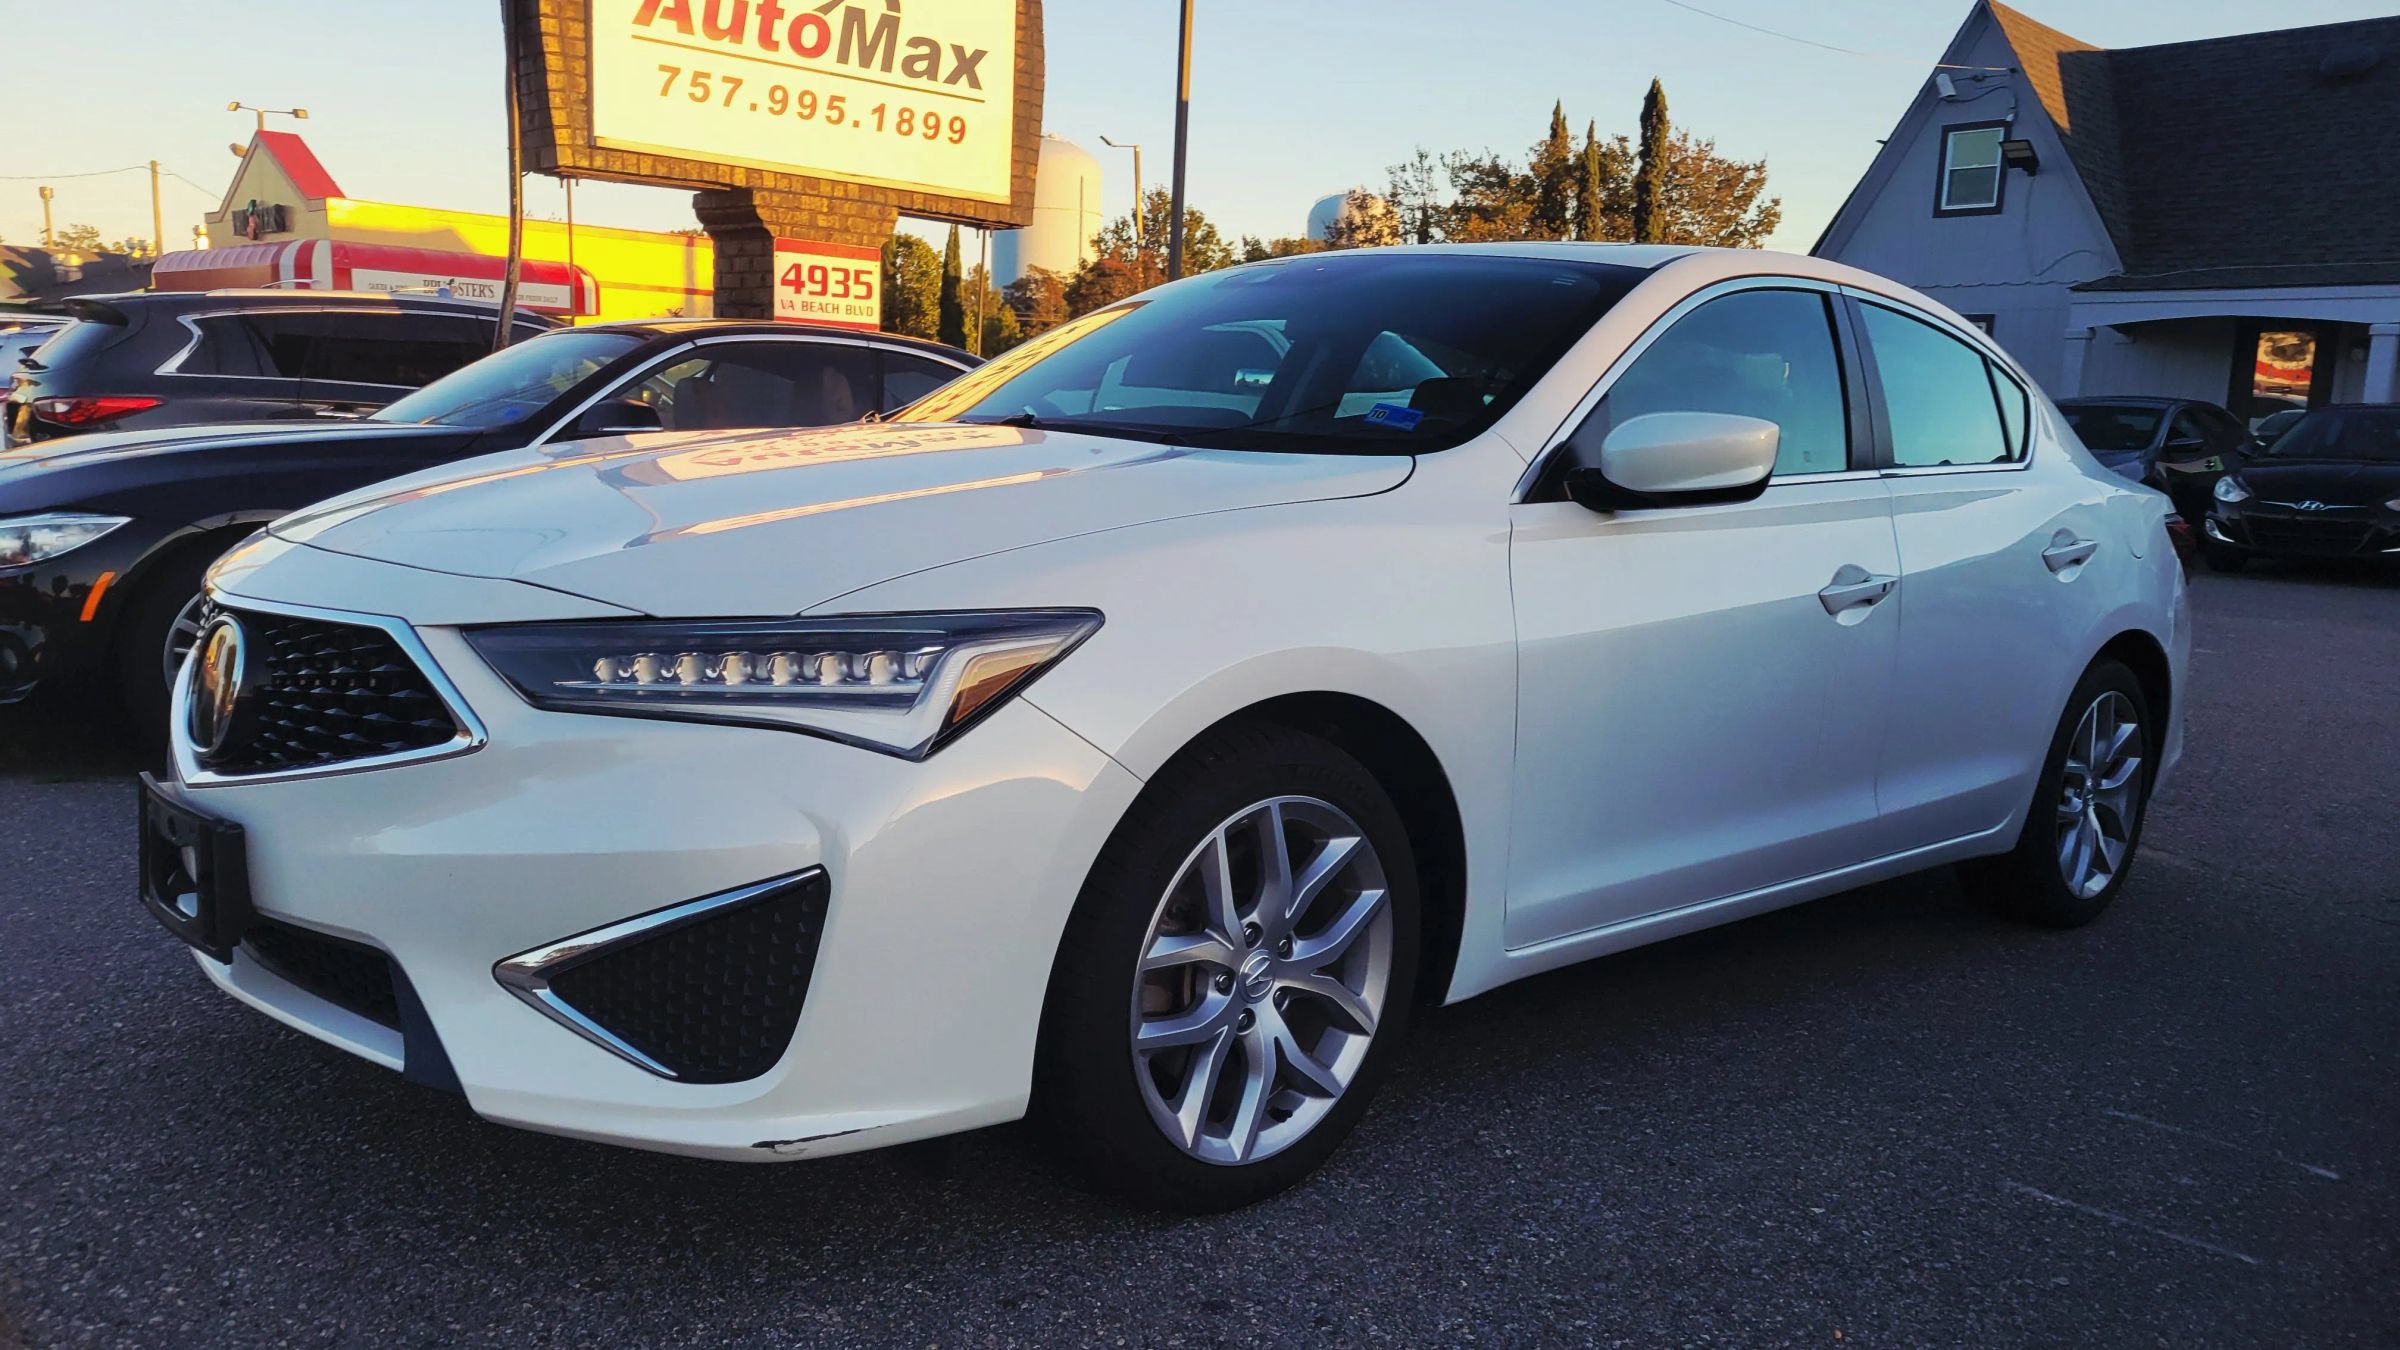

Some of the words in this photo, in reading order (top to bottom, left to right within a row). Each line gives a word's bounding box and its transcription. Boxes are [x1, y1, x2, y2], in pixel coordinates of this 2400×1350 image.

[631, 0, 989, 91] AutoMax
[656, 64, 967, 145] 757.995.1899
[780, 263, 873, 300] 4935
[780, 299, 795, 310] VA
[801, 301, 840, 314] BEACH
[845, 304, 874, 317] BLVD
[1371, 409, 1387, 419] 10
